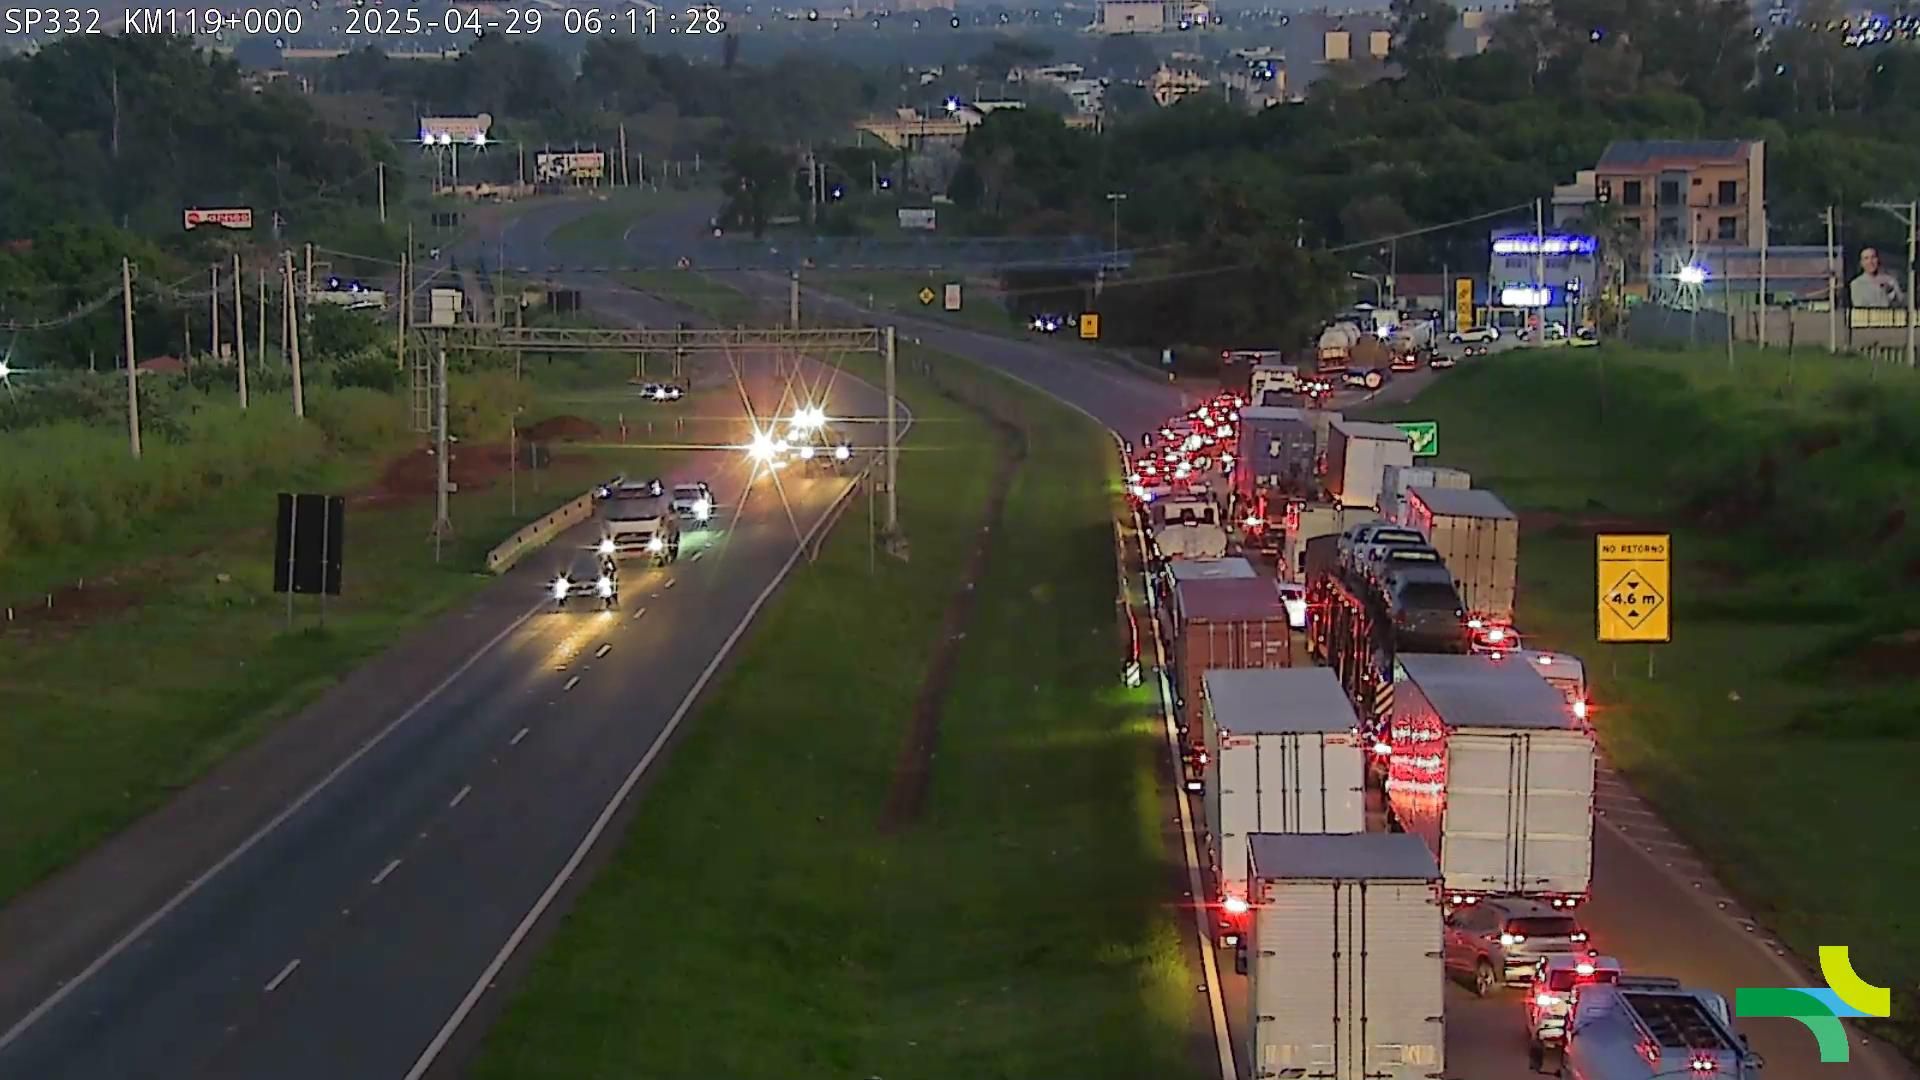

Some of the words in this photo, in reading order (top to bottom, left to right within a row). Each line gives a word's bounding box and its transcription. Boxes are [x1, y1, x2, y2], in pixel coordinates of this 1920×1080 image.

[1602, 545, 1616, 553] NO
[1621, 545, 1664, 553] RETORNO
[1642, 595, 1655, 605] m
